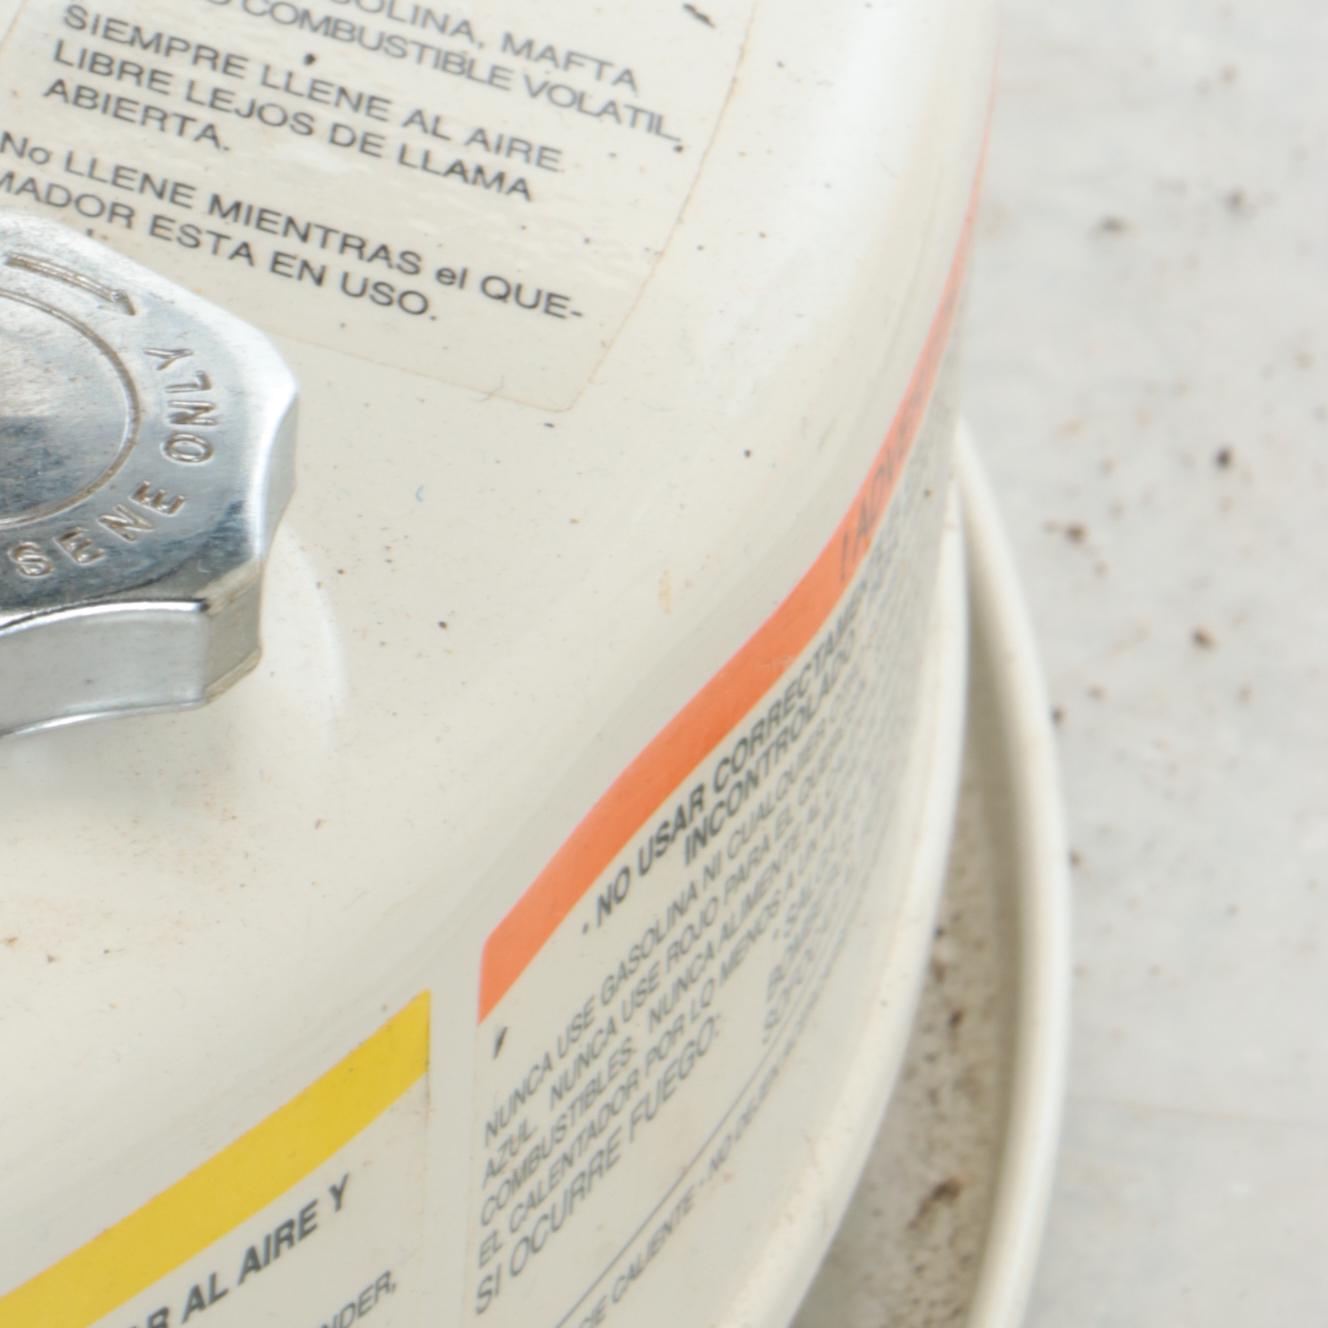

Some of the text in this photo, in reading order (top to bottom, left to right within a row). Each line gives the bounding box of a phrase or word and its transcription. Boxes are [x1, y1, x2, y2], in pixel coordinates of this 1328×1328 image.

[42, 78, 232, 154] ABIERTA.
[52, 39, 533, 203] LIBRE LEJOS DE LLAMA
[63, 2, 566, 174] SIEMPRE LLENE AL AIRE
[63, 151, 196, 210] LLENE
[208, 195, 424, 278] MIENTRAS
[435, 262, 468, 290] el
[478, 274, 584, 322] QUE-
[148, 214, 257, 268] ESTA
[269, 253, 328, 289] EN
[338, 274, 439, 323] USO.
[144, 345, 223, 467] ONLY
[596, 865, 632, 928] NO
[637, 782, 706, 878] USAR
[484, 1050, 554, 1148] NUNCA
[557, 997, 597, 1060] USE
[600, 880, 698, 1006] GASOLINA
[549, 1016, 618, 1111] NUNCA
[621, 961, 661, 1023] USE
[666, 895, 719, 976] ROJO
[647, 940, 716, 1034] NUNCA
[476, 1263, 503, 1316] SI
[508, 1125, 623, 1278] OCURRE
[479, 1229, 503, 1269] EL
[508, 1068, 640, 1234] CALENTADOR
[645, 1012, 686, 1078] POR
[181, 1271, 230, 1325] AL
[236, 1197, 320, 1287] AIRE
[327, 1171, 351, 1214] Y
